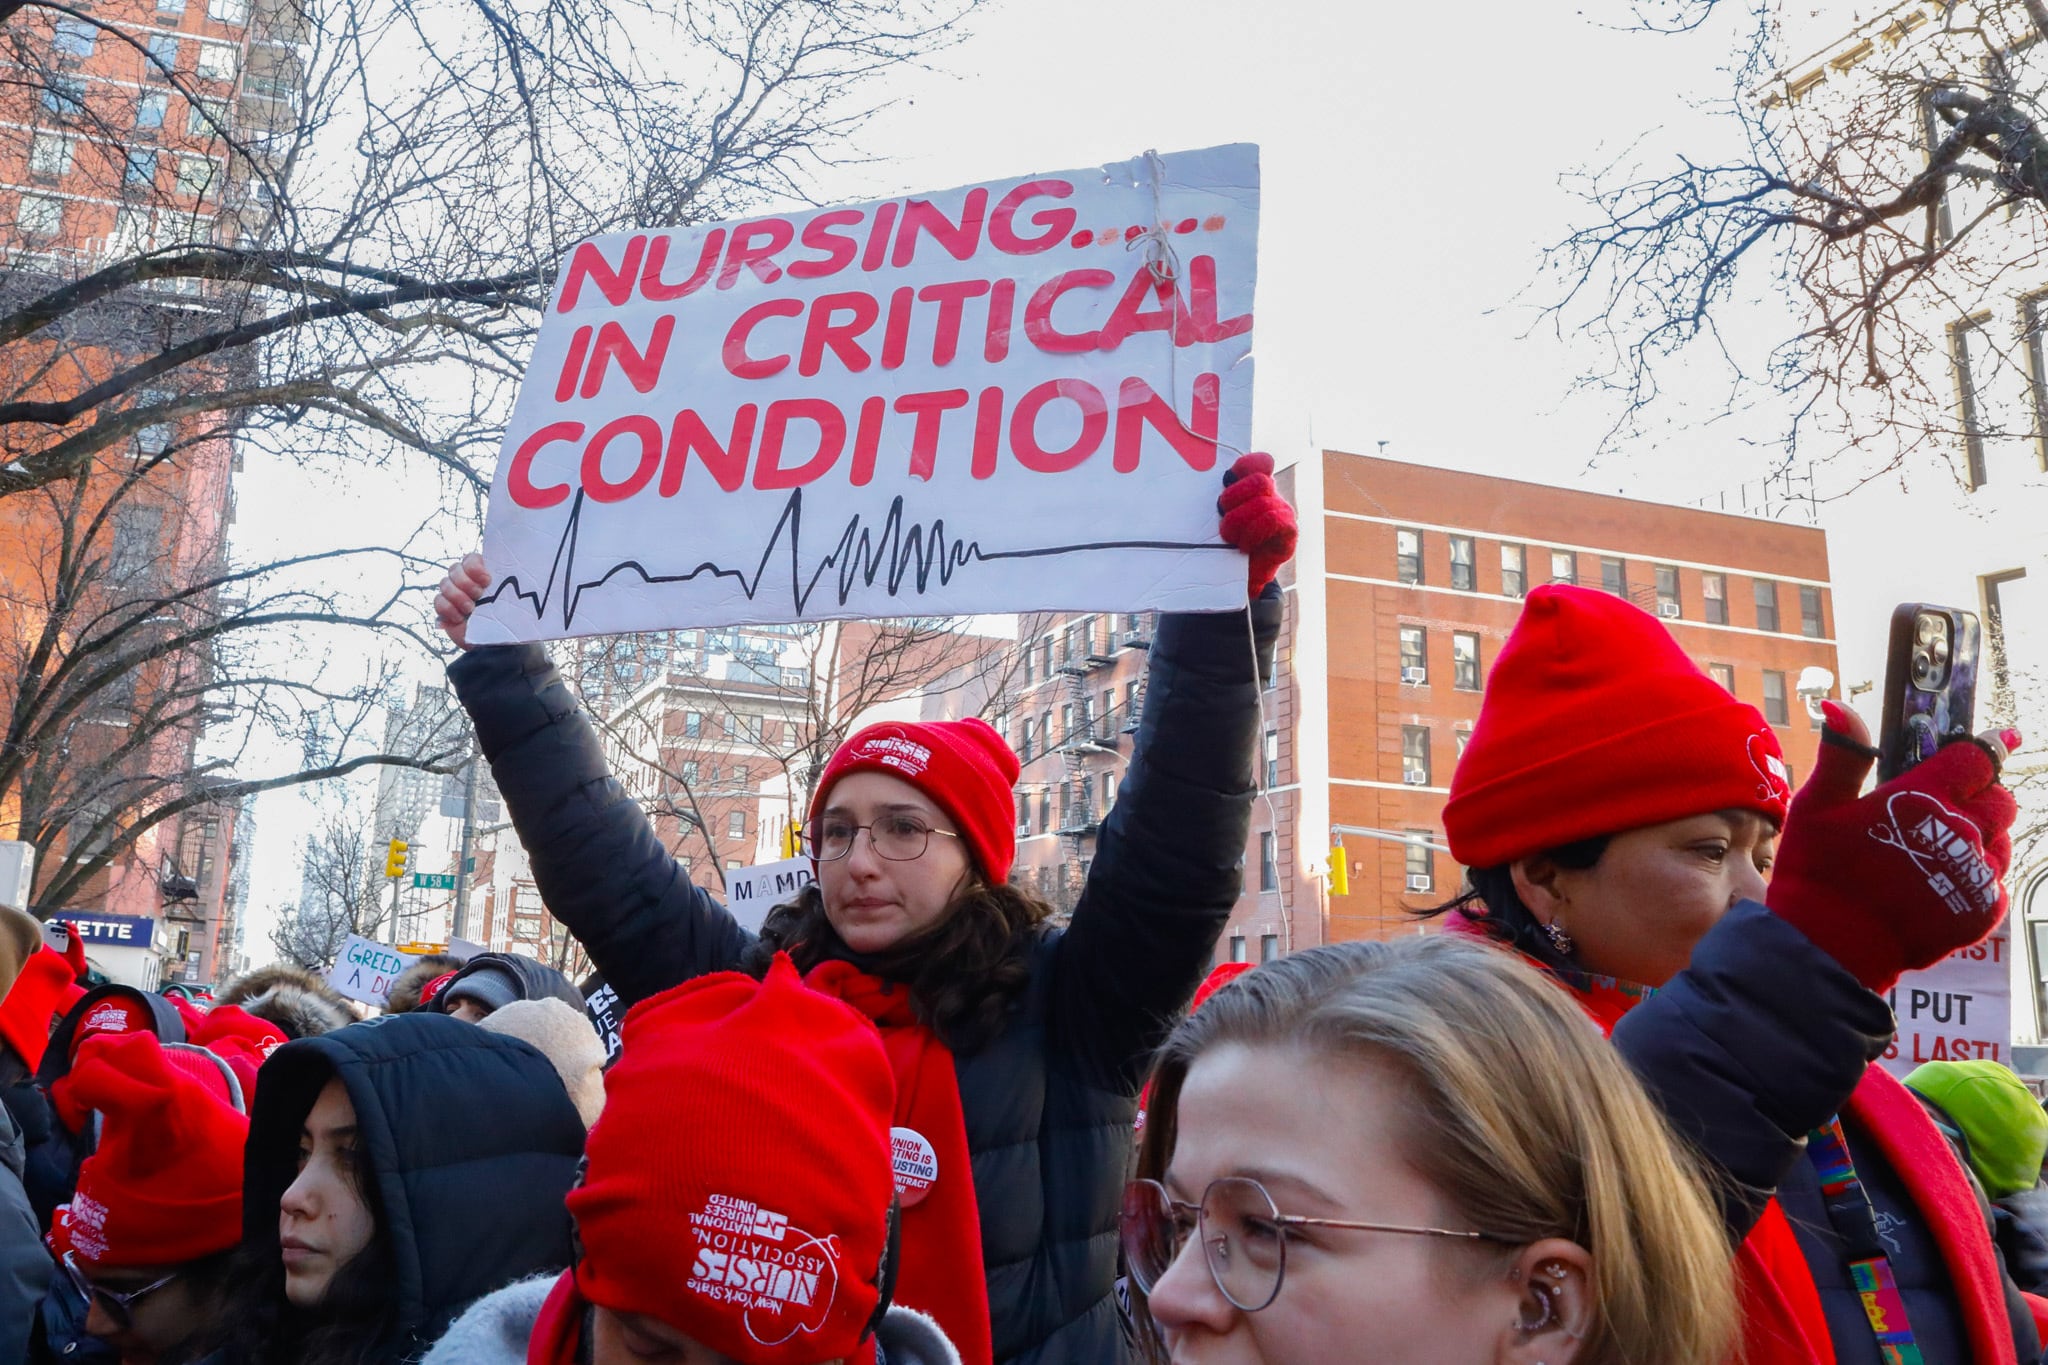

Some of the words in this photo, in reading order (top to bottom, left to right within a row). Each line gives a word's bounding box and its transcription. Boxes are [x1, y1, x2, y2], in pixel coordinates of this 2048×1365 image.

[555, 314, 675, 402] IN
[723, 255, 1253, 379] CRITICAL
[507, 372, 1220, 510] CONDITION
[420, 875, 428, 886] W
[430, 875, 442, 887] 58
[44, 918, 133, 940] ETTE
[347, 943, 401, 975] GREED
[347, 968, 360, 989] A
[1911, 989, 1973, 1026] PUT
[890, 1137, 921, 1152] UNION
[893, 1159, 934, 1177] USTING
[920, 1154, 932, 1165] IS
[894, 1174, 929, 1189] NTRACT
[704, 1203, 755, 1226] NURSES
[709, 1193, 757, 1214] UNITED
[688, 1212, 752, 1236] NATIONAL
[692, 1247, 820, 1307] NURSES
[687, 1277, 724, 1301] State
[725, 1286, 755, 1310] York
[755, 1295, 783, 1316] New
